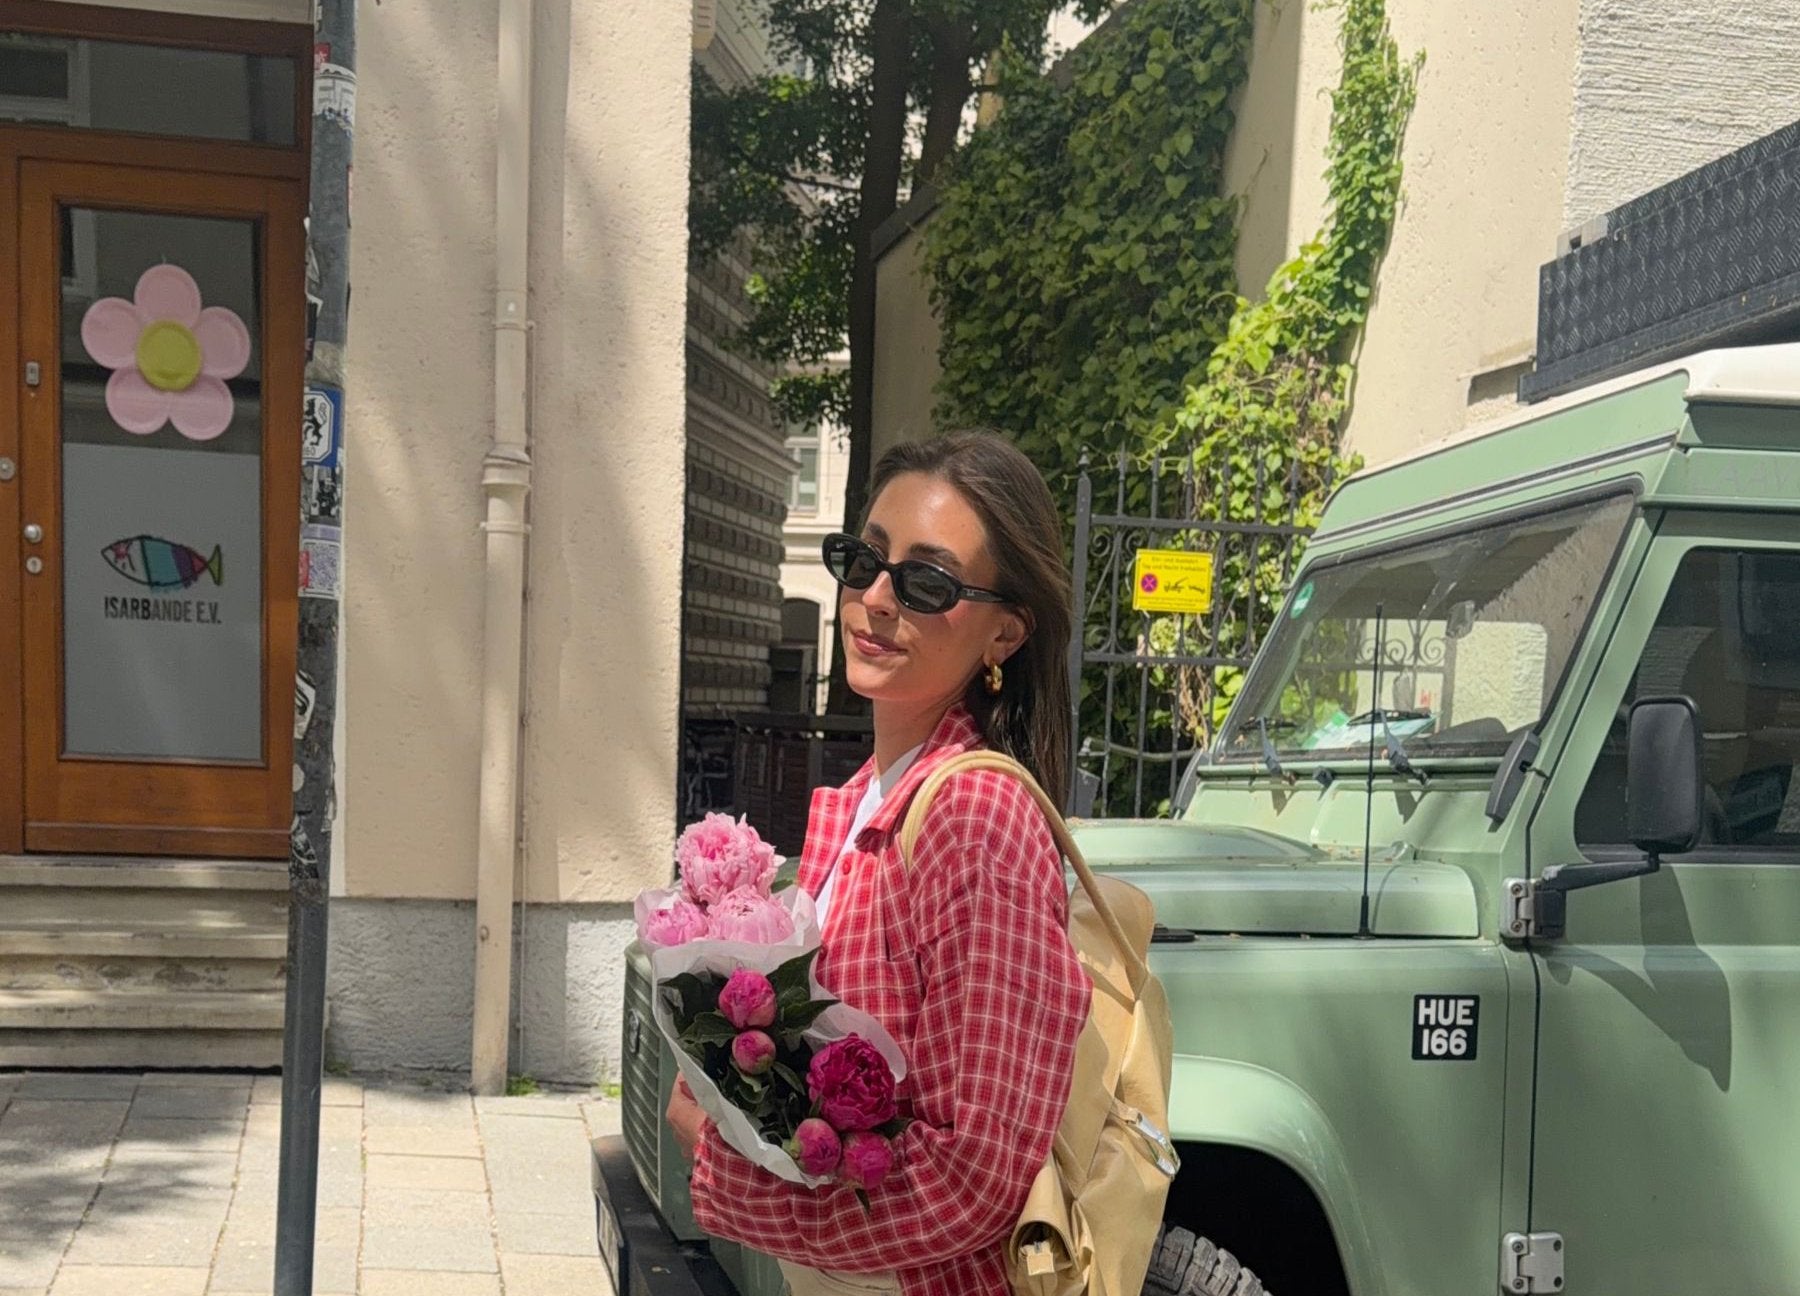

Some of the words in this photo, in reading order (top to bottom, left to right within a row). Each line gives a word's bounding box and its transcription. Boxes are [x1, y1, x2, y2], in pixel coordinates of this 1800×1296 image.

[104, 596, 192, 623] ISARBANDE
[196, 601, 222, 624] E.V.
[1418, 999, 1475, 1026] HUE
[1422, 1028, 1467, 1056] 166
